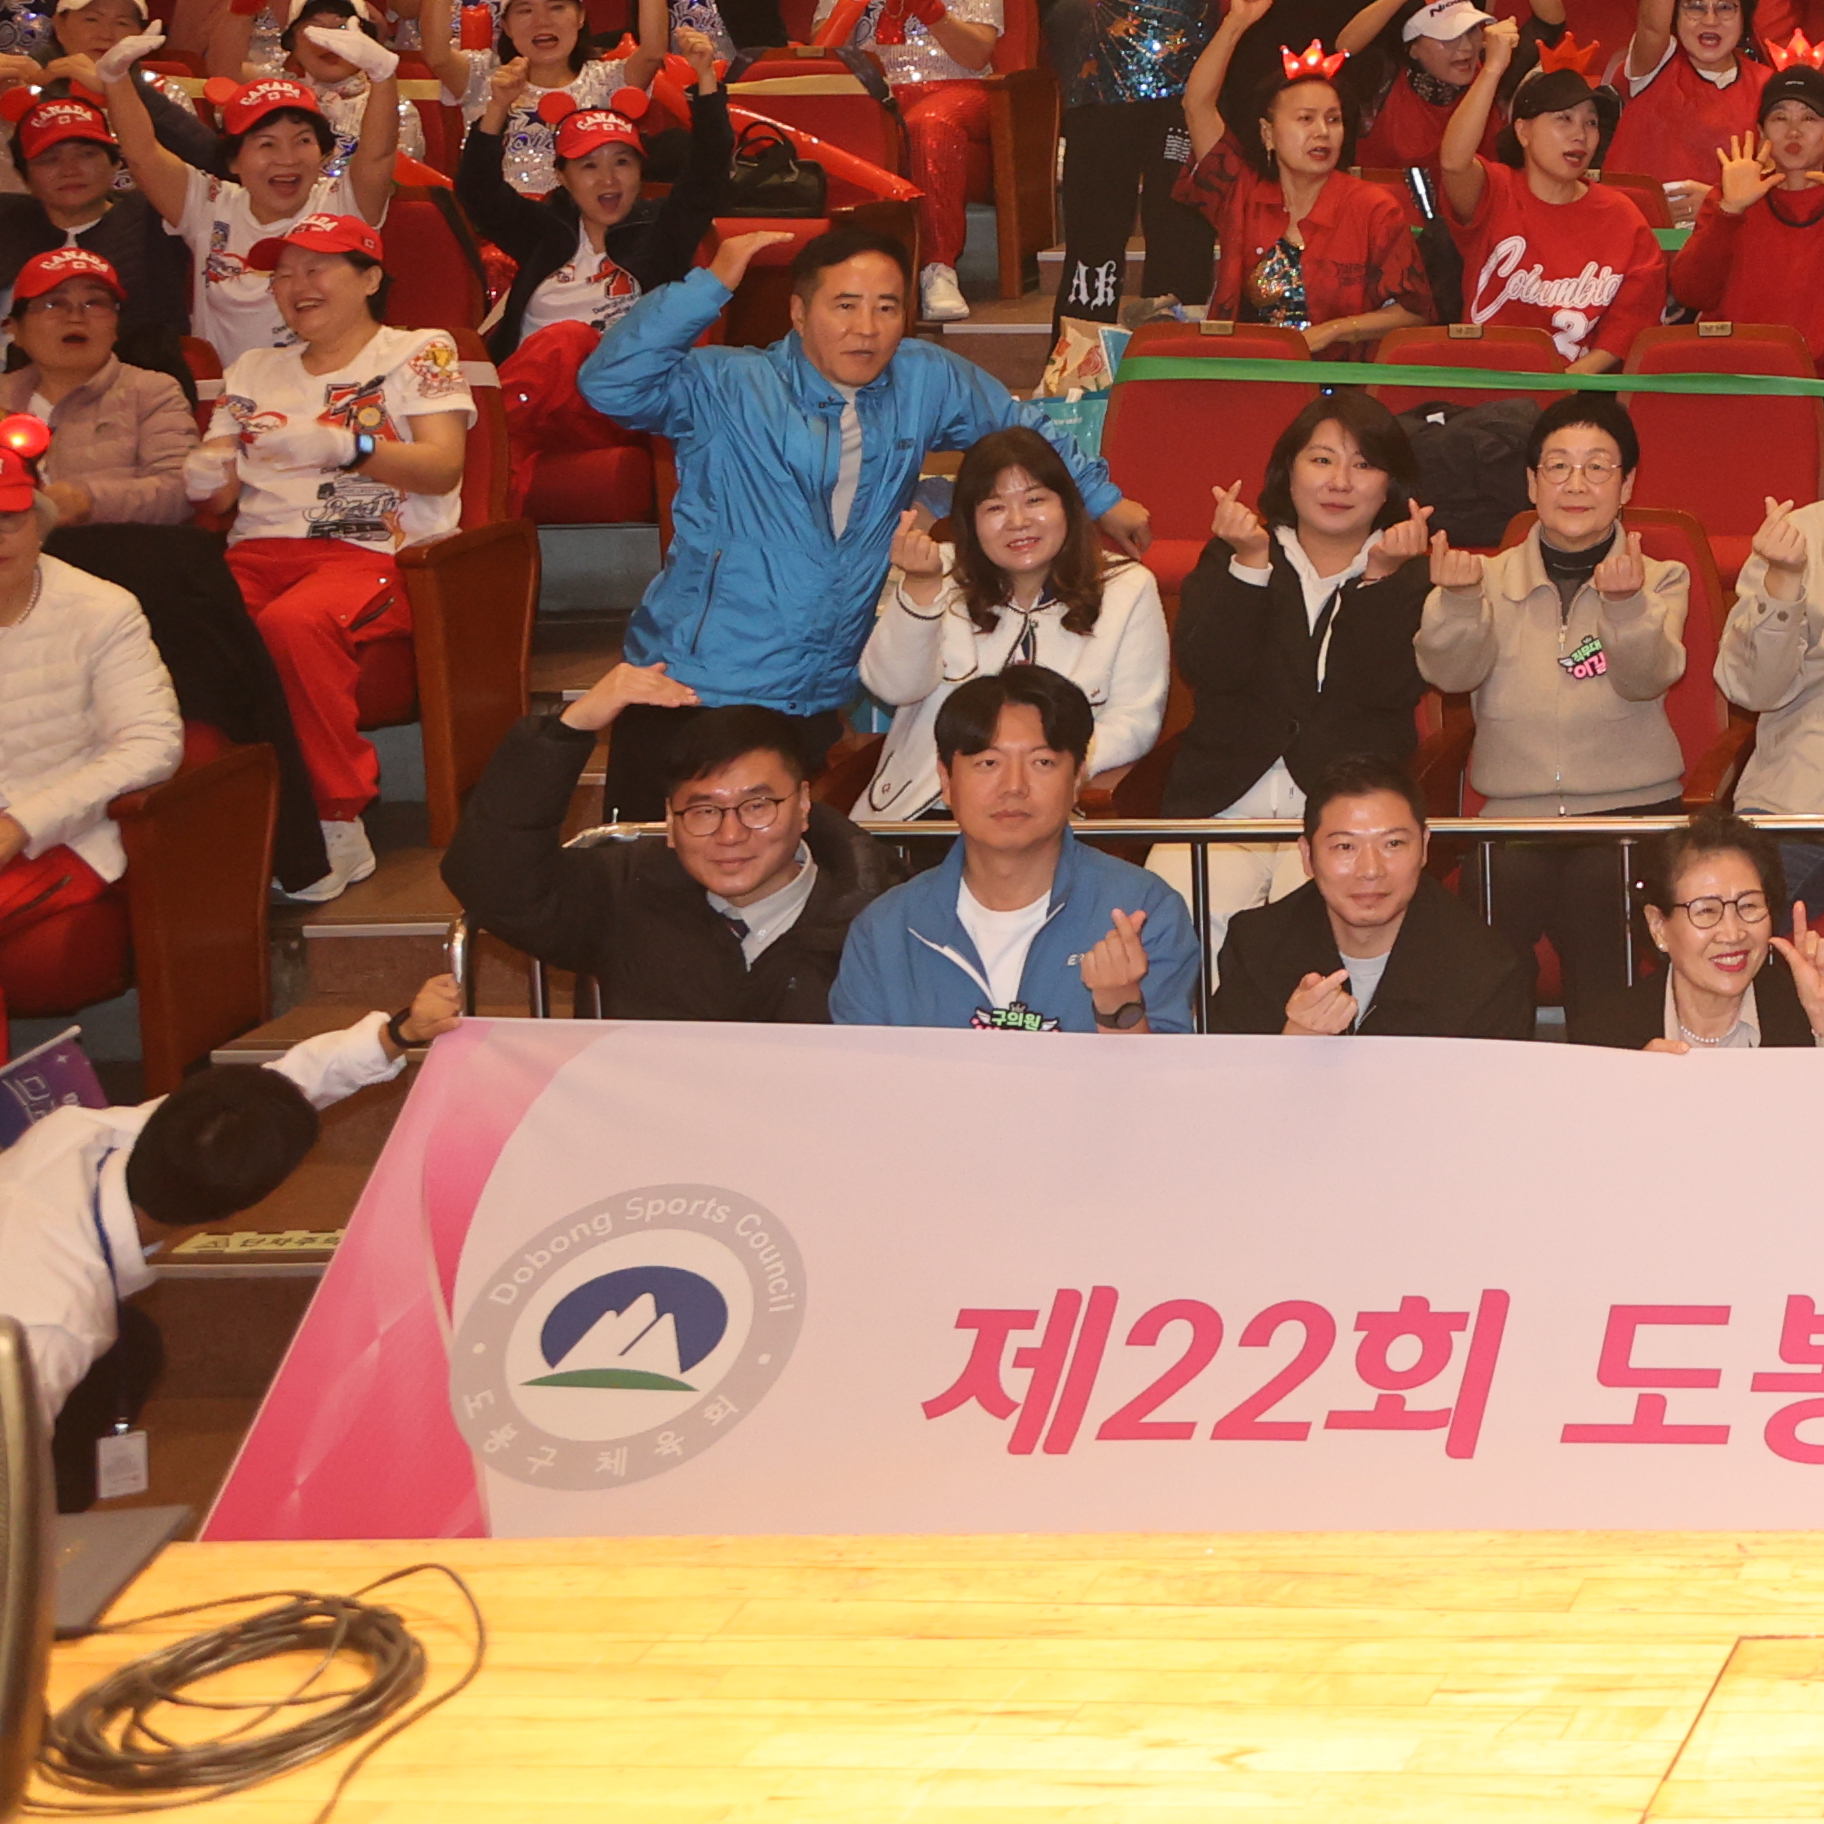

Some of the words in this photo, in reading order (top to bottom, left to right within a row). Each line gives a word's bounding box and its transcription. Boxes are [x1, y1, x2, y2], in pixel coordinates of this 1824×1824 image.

[239, 81, 301, 106] CANADA
[31, 104, 94, 128] CANADA
[576, 111, 633, 133] CANADA
[39, 250, 109, 272] CANADA
[1571, 639, 1603, 662] 직무대
[1573, 651, 1608, 679] 이길
[991, 1010, 1042, 1032] 구의원
[488, 1211, 614, 1308] Dobong
[626, 1194, 733, 1227] Sports
[735, 1213, 796, 1314] Council
[920, 1284, 1512, 1461] 제22회
